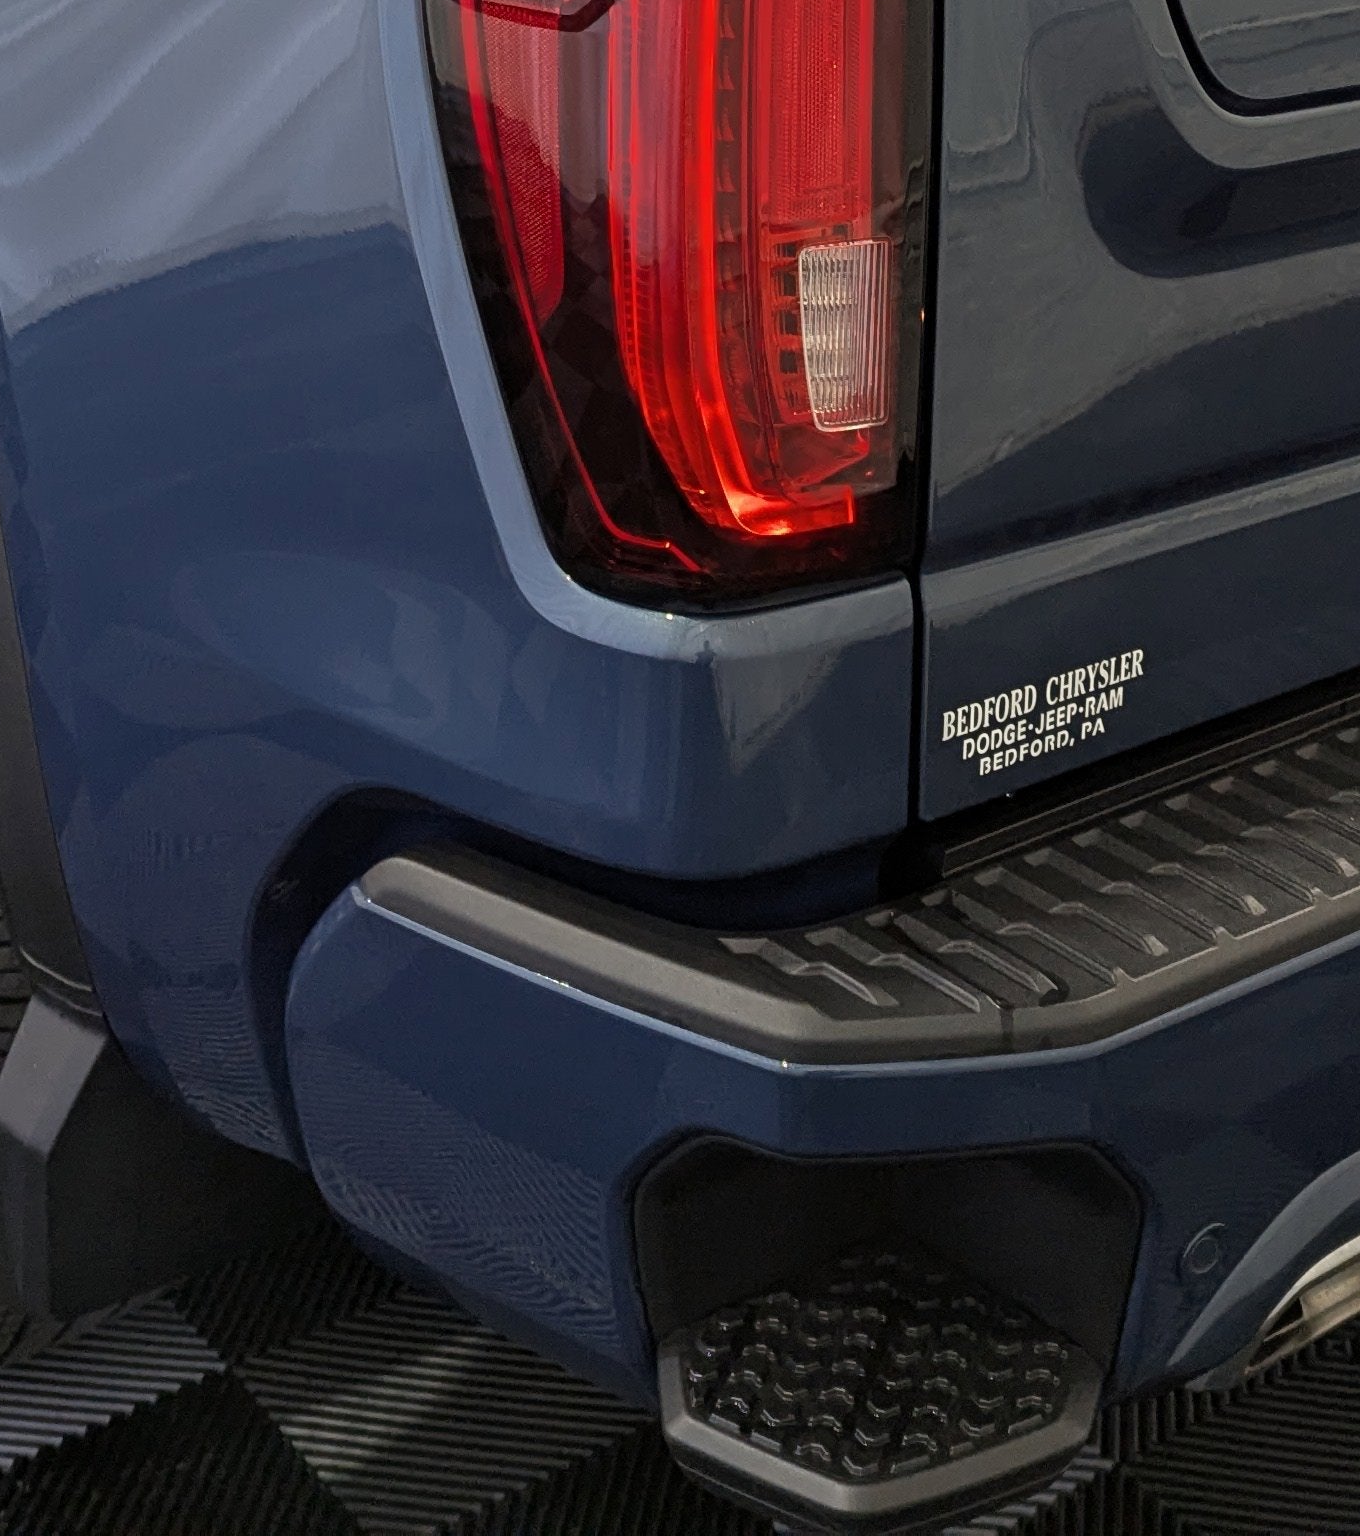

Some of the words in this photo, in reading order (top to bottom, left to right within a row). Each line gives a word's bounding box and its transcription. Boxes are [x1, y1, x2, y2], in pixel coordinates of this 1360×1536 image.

[941, 684, 1037, 742] BEDFORD
[1045, 648, 1144, 706] CHRYSLER
[979, 730, 1075, 776] BEDFORD,
[1081, 717, 1106, 741] PA
